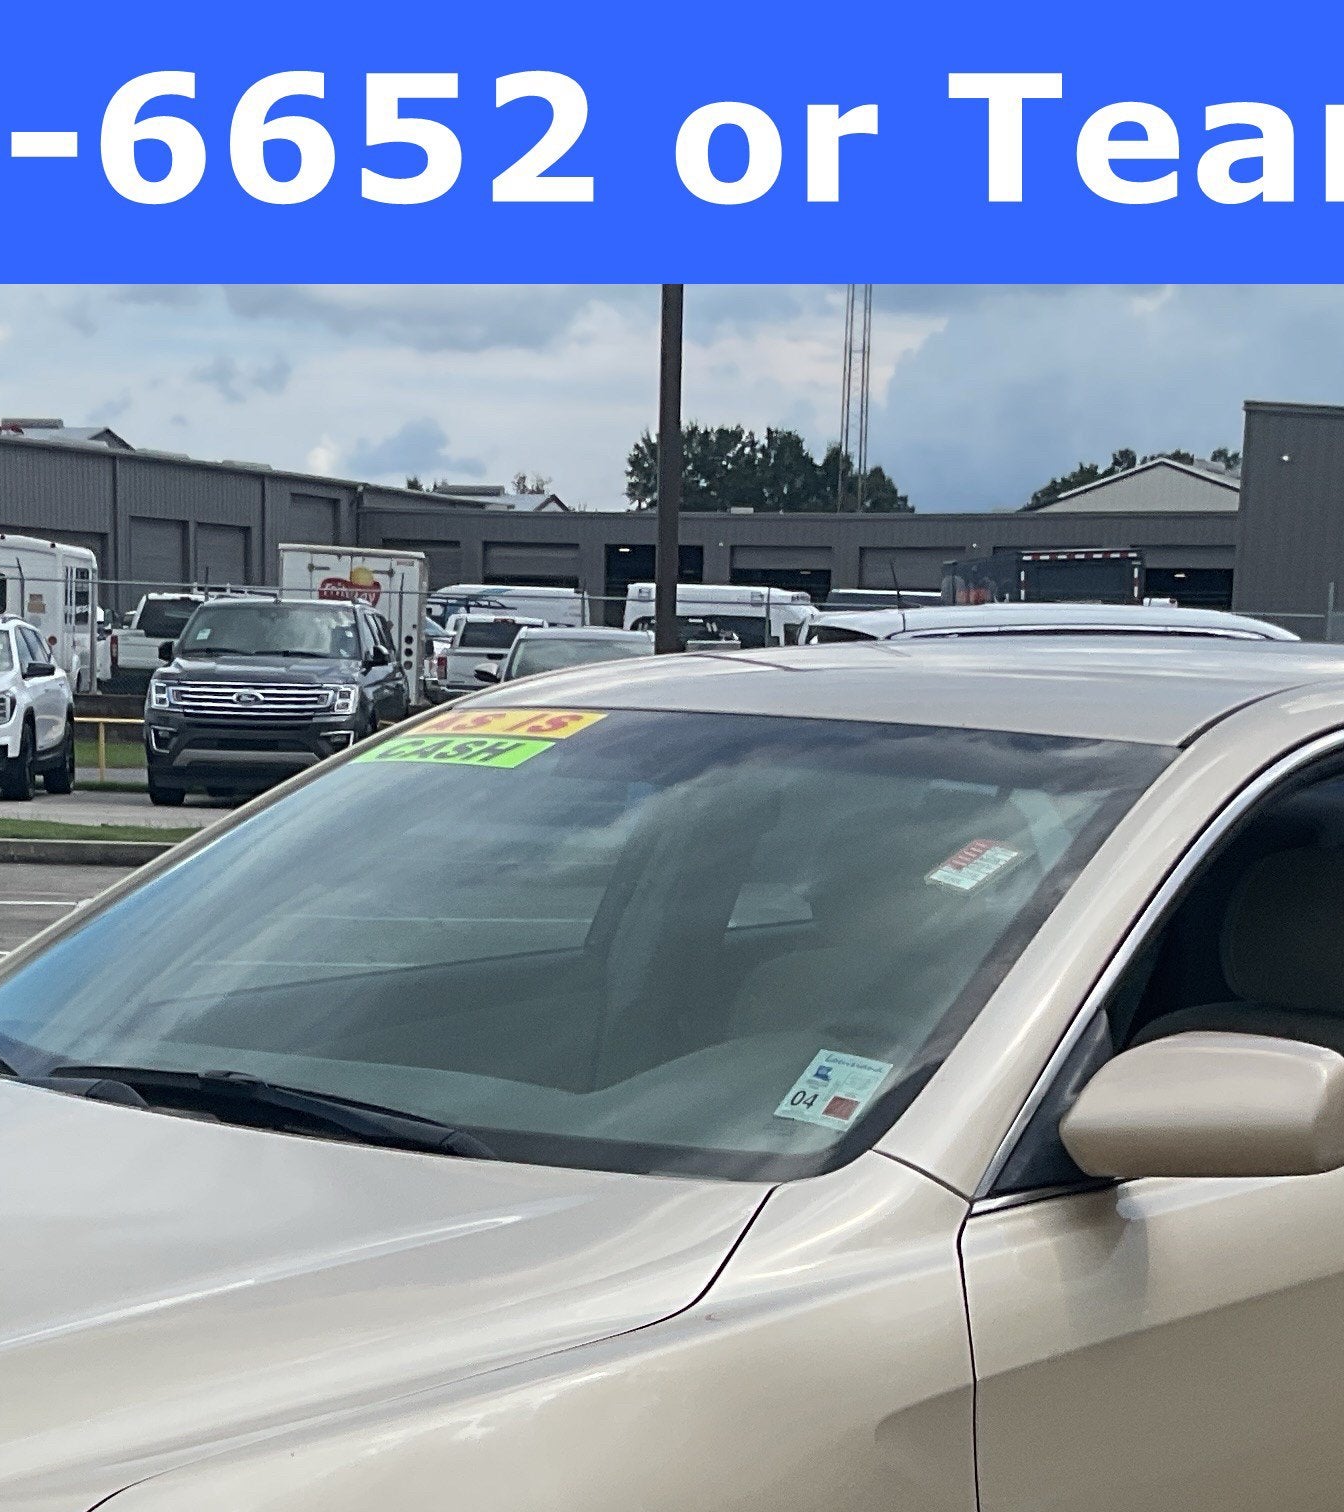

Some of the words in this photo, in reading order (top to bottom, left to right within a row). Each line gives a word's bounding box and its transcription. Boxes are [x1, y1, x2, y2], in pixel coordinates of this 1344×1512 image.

[420, 712, 506, 733] AS
[502, 713, 585, 733] IS
[378, 738, 526, 763] CASH
[790, 1090, 819, 1109] 04
